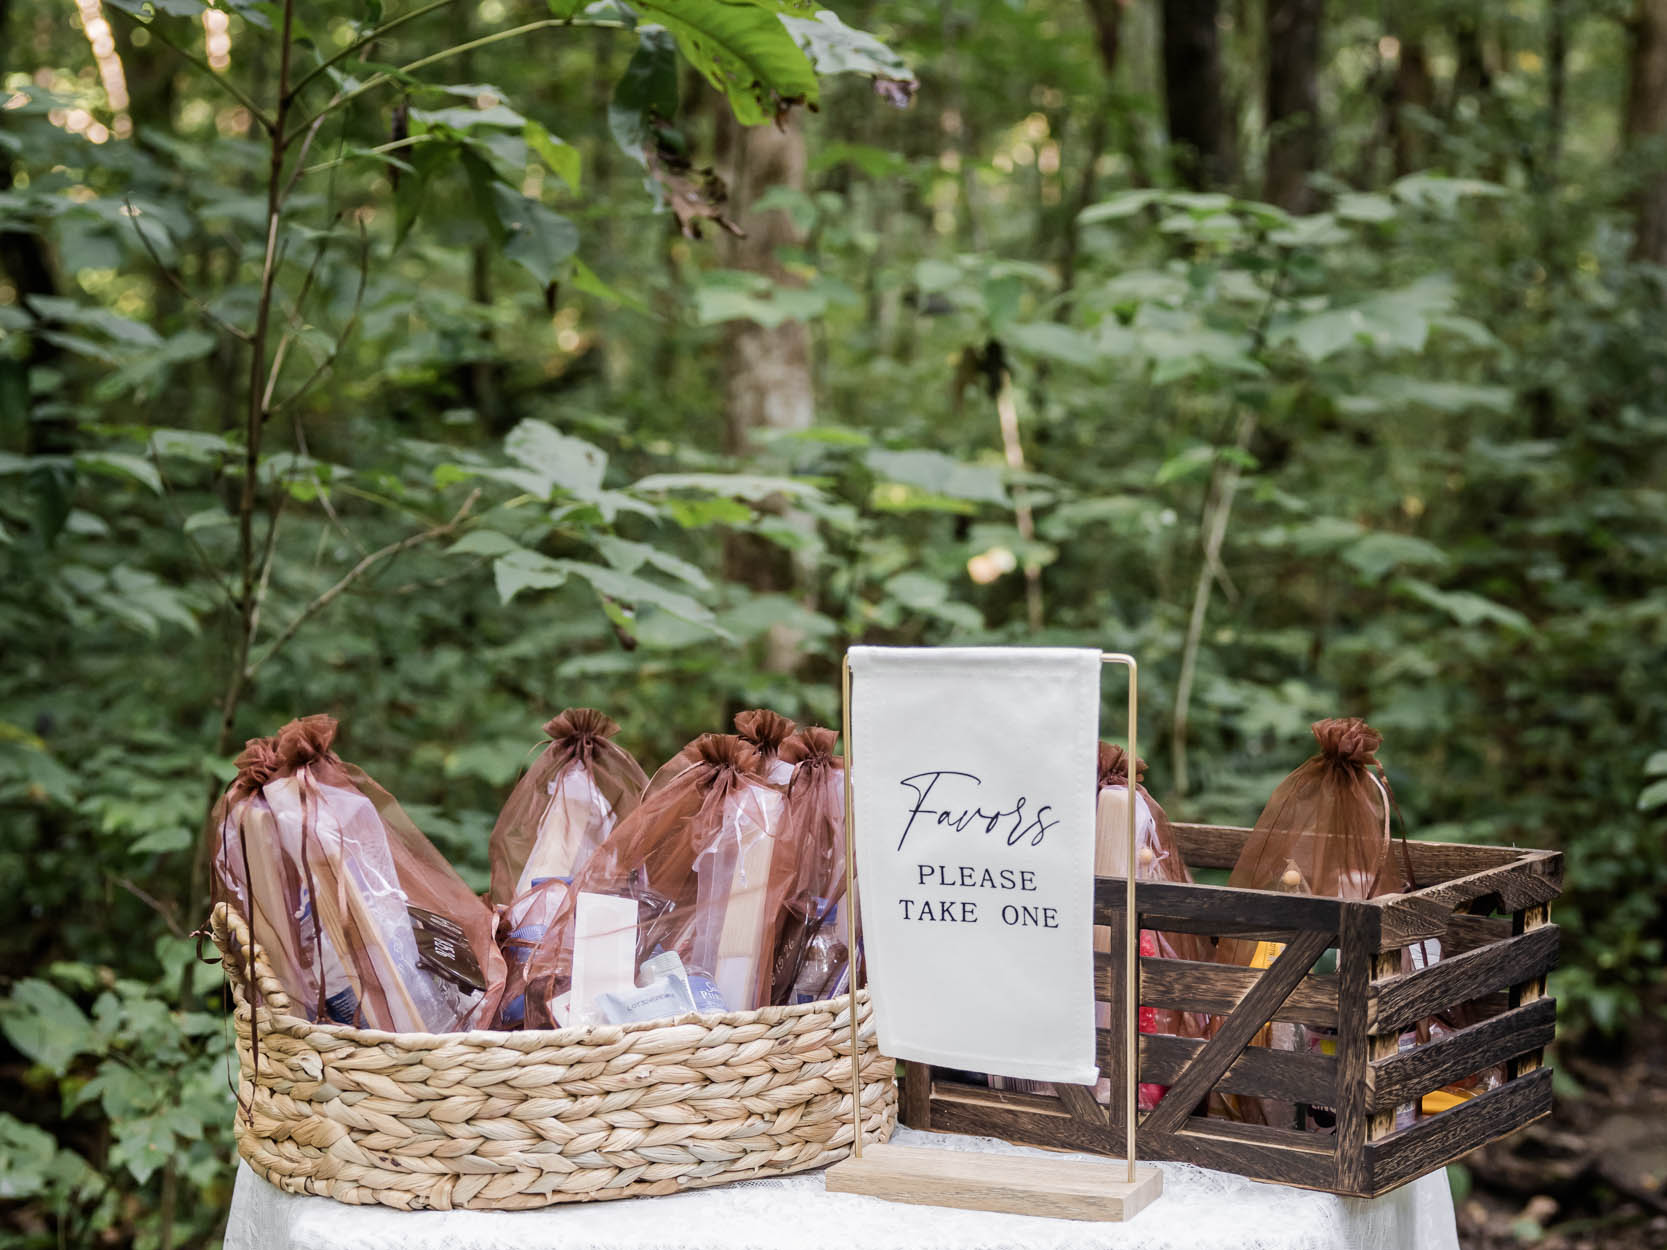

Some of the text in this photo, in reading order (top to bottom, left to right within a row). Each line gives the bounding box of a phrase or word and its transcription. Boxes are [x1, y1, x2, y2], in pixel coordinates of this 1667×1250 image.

[897, 771, 1061, 852] Favors
[917, 864, 1038, 892] PLEASE
[898, 899, 1060, 929] TAKE ONE
